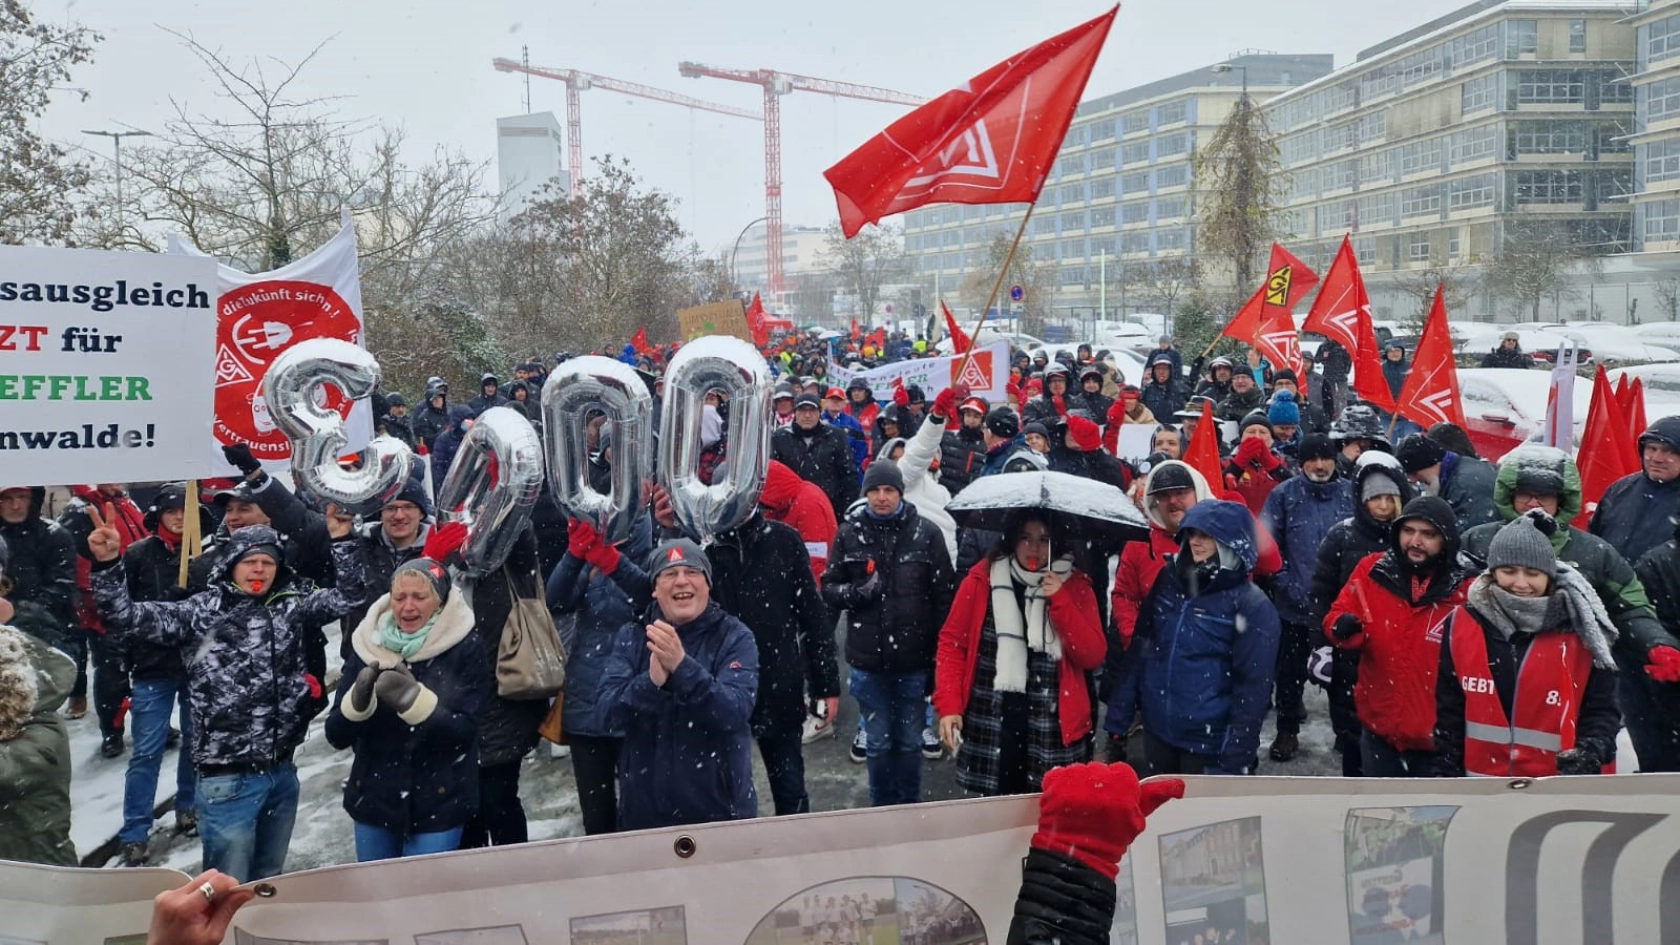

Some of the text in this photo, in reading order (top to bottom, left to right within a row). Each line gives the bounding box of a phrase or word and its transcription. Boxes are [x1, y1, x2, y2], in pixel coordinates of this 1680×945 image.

[0, 280, 210, 312] sausgleich
[61, 327, 122, 353] für
[0, 375, 152, 400] EFFLER
[0, 424, 155, 450] nwalde!
[214, 418, 290, 452] ertrauensl
